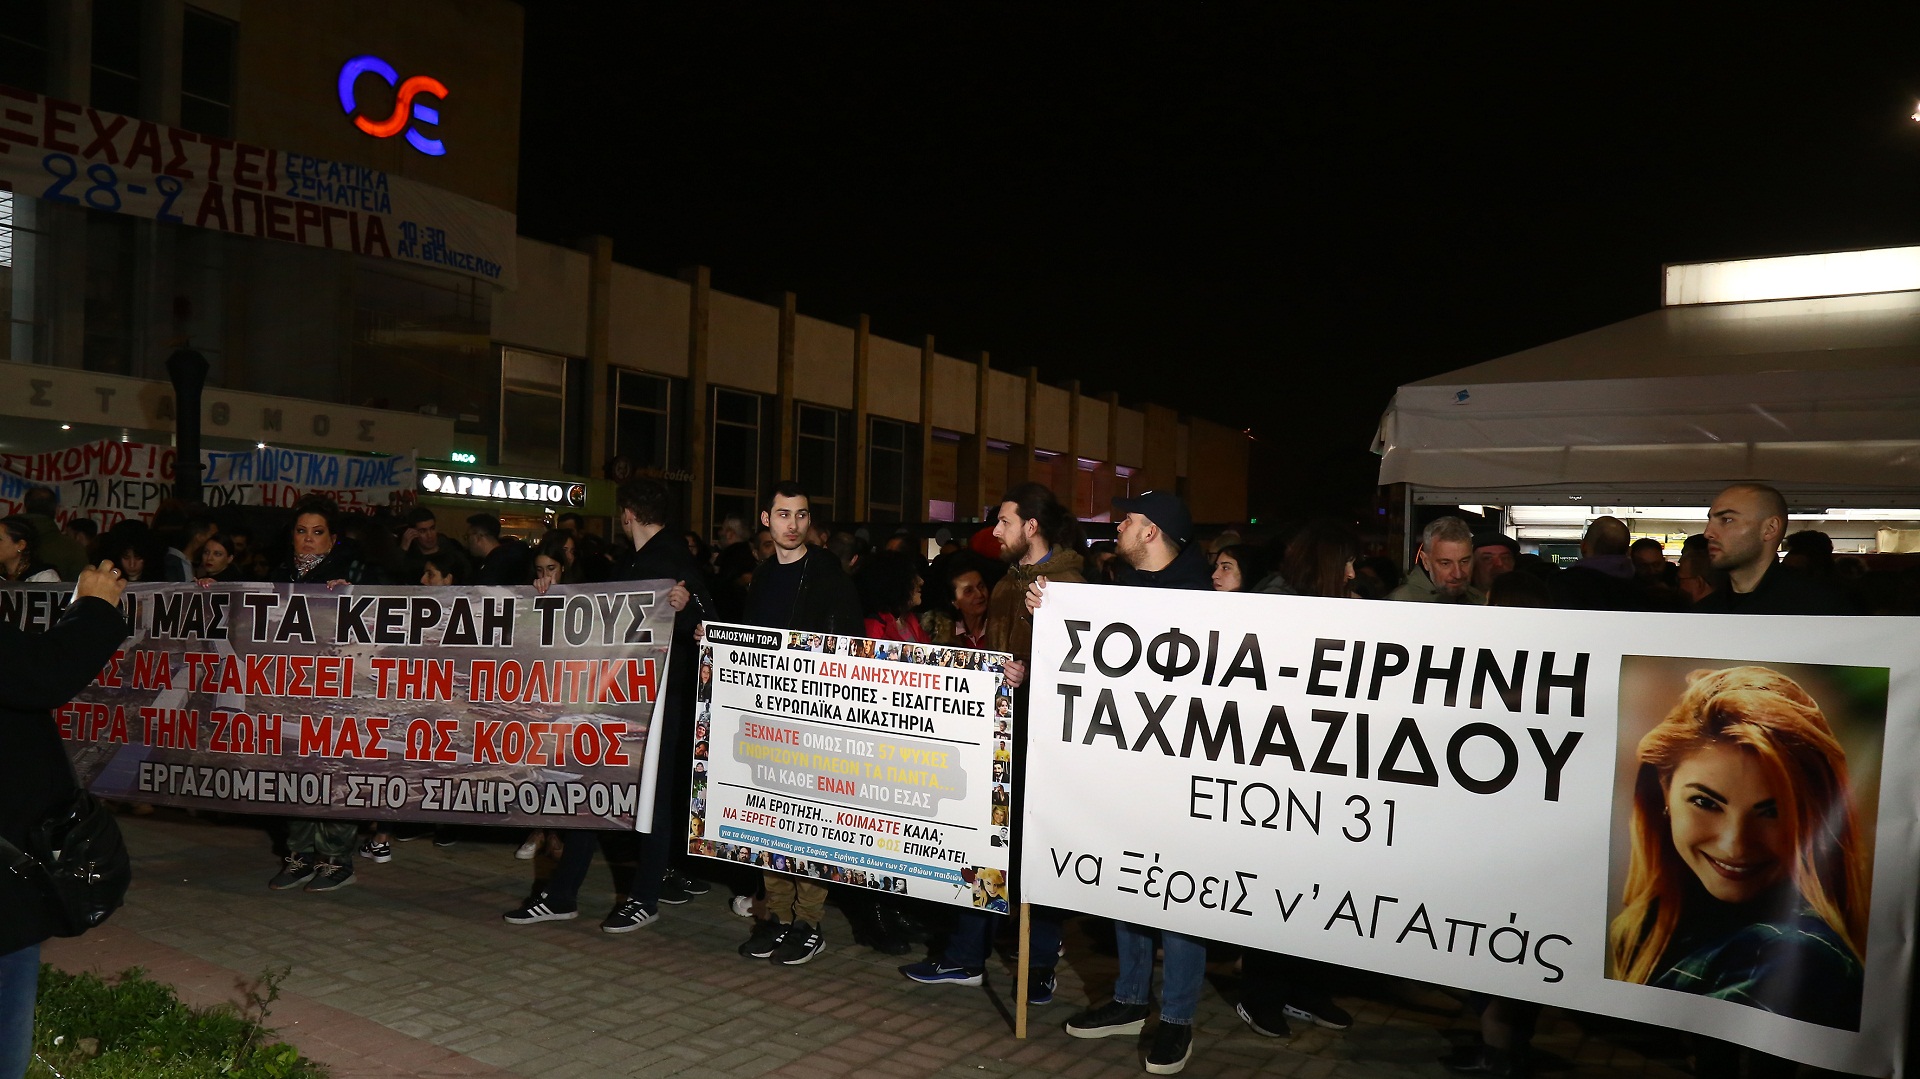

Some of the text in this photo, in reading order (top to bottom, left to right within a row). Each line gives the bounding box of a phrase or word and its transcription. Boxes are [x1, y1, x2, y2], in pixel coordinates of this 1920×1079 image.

[286, 152, 388, 192] ΕΡΓΑΤΙΚΑ
[287, 173, 392, 214] ΣΩΜΑΤΕΙΑ
[196, 182, 392, 259] ΑΠΕΡΓΙΑ
[398, 221, 446, 249] 10:30
[422, 243, 501, 279] ΒΕΝΙΖΕΛΟΥ
[0, 440, 157, 481] ΣΗΚΩΜΟΣ!
[74, 479, 99, 507] ΤΑ
[422, 473, 563, 502] ΦΑΡΜΑΚΕΙΟ
[152, 592, 231, 640] ΜΑΣ
[244, 593, 316, 643] ΤΑ
[336, 595, 516, 647] ΚΕΡΔΗ
[533, 591, 655, 647] ΤΟΥΣ
[708, 629, 778, 647] ΔΙΚΑΙΟΣΥΝΗ ΤΩΡΑ
[132, 650, 172, 690] ΝΑ
[184, 652, 354, 698] ΤΣΑΚΙΣΕΙ
[371, 657, 454, 701] ΤΗΝ
[469, 658, 657, 703] ΠΟΛΙΤΙΚΗ
[720, 668, 798, 693] ΕΞΕΤΑΣΤΙΚΕΣ
[801, 680, 878, 704] ΕΠΙΤΡΟΠΕΣ
[892, 691, 985, 717] ΕΙΣΑΓΓΕΛΙΕΣ
[729, 650, 970, 694] ΦΑΙΝΕΤΑΙ ΟΤΙ ΔΕΝ ΑΝΗΣΥΧΕΙΤΕ ΓΙΑ
[49, 702, 630, 767] ΕΤΡΑ ΤΗΝ ΖΩΗ ΜΑΣ ΩΣ ΚΟΣΤΟΣ
[755, 694, 935, 733] & ΕΥΡΩΠΑΪΚΑ ΔΙΚΑΣΤΗΡΙΑ
[739, 741, 809, 768] ΓΝΩΡΙΖΟΥΝ
[813, 755, 859, 777] ΠΛΕΟΝ
[864, 762, 882, 780] ΤΑ
[744, 722, 949, 769] ΞΕΧΝΑΤΕ ΟΜΩΣ ΠΩΣ 57 ΨΥΧΕΣ
[1057, 683, 1585, 802] ΤΑΧΜΑΖΙΔΟΥ
[139, 761, 332, 805] ΕΡΓΑΖΟΜΕΝΟΙ
[345, 774, 408, 809] ΣΤΟ
[757, 764, 931, 809] ΓΙΑ ΚΑΘΕ ΕΝΑΝ ΑΠΟ ΕΣΑΣ
[745, 794, 944, 845] ΜΙΑ ΕΡΩΤΗΣΗ... ΚΟΙΜΑΣΤΕ ΚΑΛΑ;
[1190, 775, 1396, 847] ΕΤΩΝ 31
[723, 807, 969, 865] ΝΑ ΞΕΡΕΤΕ ΟΤΙ ΣΤΟ ΤΕΛΟΣ ΤΟ ΦΩΣ ΕΠΙΚΡΑΤΕΙ.
[1050, 847, 1103, 886] να
[1117, 850, 1258, 917] ΞέρειΣ
